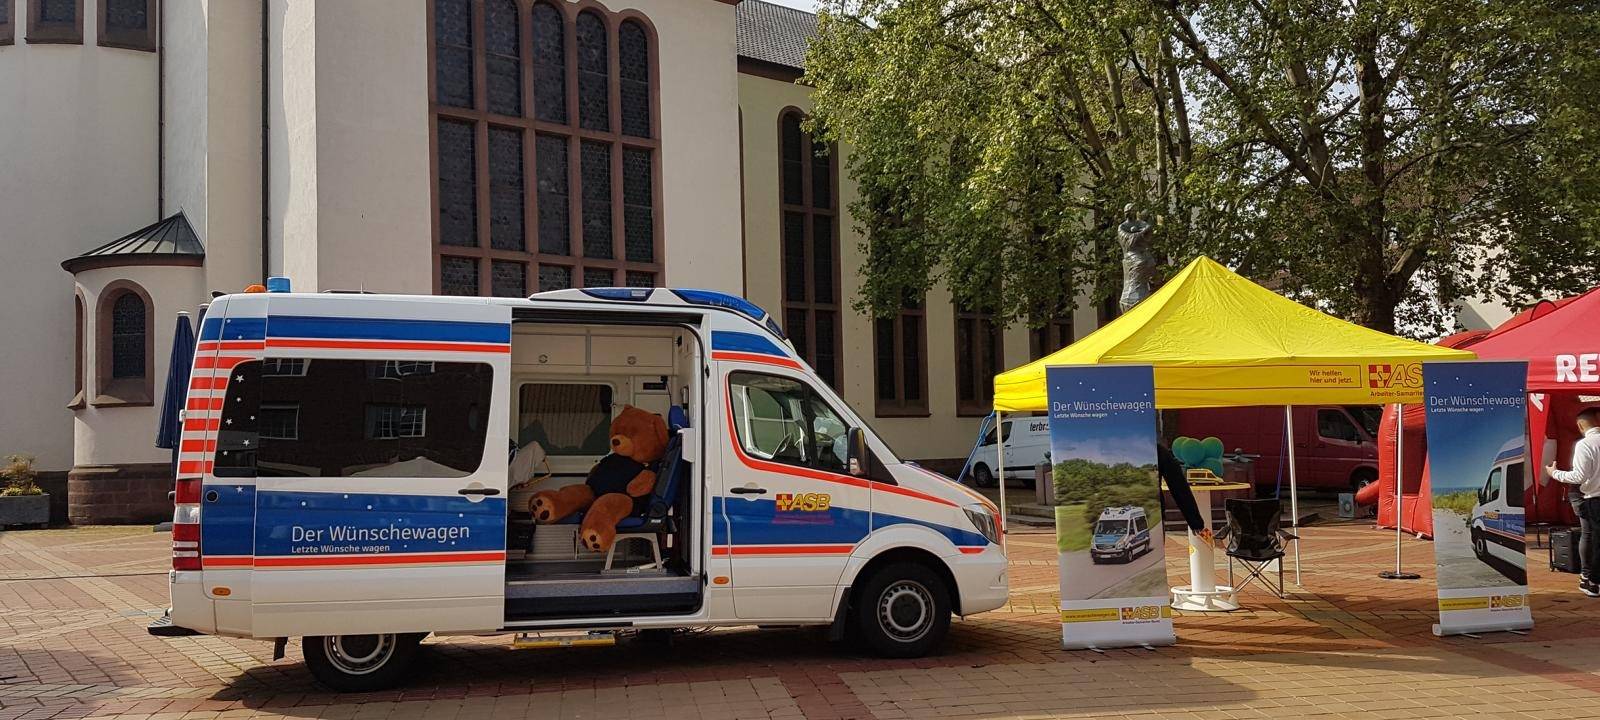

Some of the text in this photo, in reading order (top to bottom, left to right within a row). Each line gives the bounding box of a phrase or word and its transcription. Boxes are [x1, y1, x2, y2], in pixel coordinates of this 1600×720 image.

[1386, 362, 1424, 388] AS
[1556, 353, 1600, 383] RE
[1053, 400, 1152, 412] Der Wünschewagen
[1430, 396, 1448, 406] Der
[1450, 395, 1526, 407] Wünschewagen
[790, 492, 831, 512] ASB
[292, 523, 470, 544] Der Wünschewagen
[291, 544, 390, 554] Letzte Wünsche wagen
[1132, 606, 1160, 619] ASB
